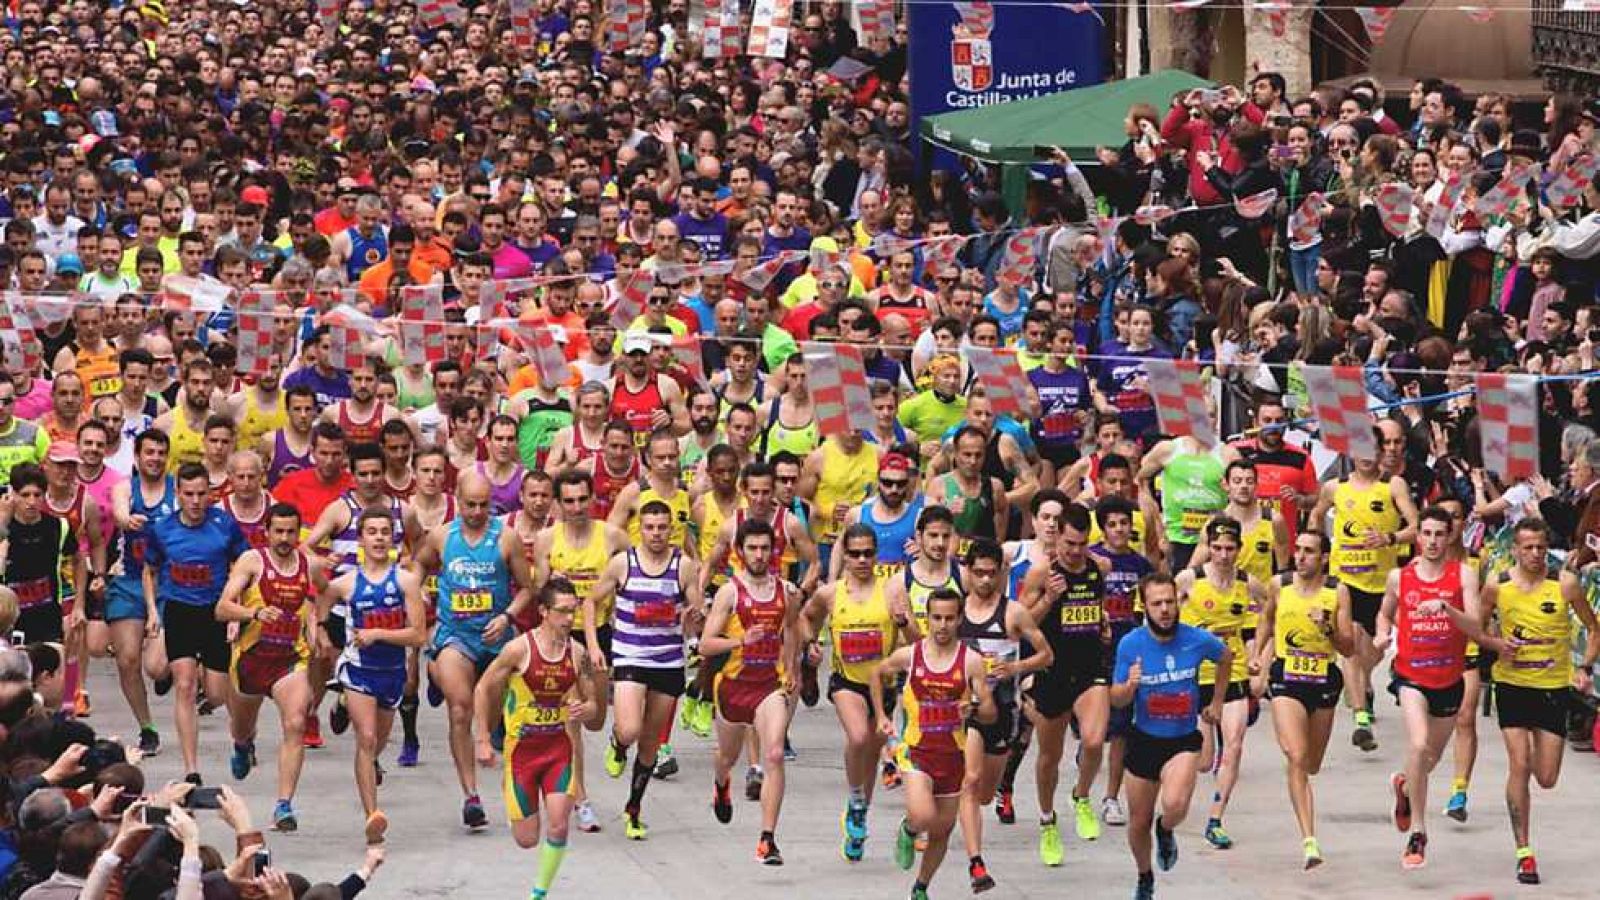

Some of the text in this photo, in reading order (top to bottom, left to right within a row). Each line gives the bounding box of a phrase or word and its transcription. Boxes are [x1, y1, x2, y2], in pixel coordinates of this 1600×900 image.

[995, 67, 1076, 89] Junta de
[946, 90, 1011, 108] Castilla
